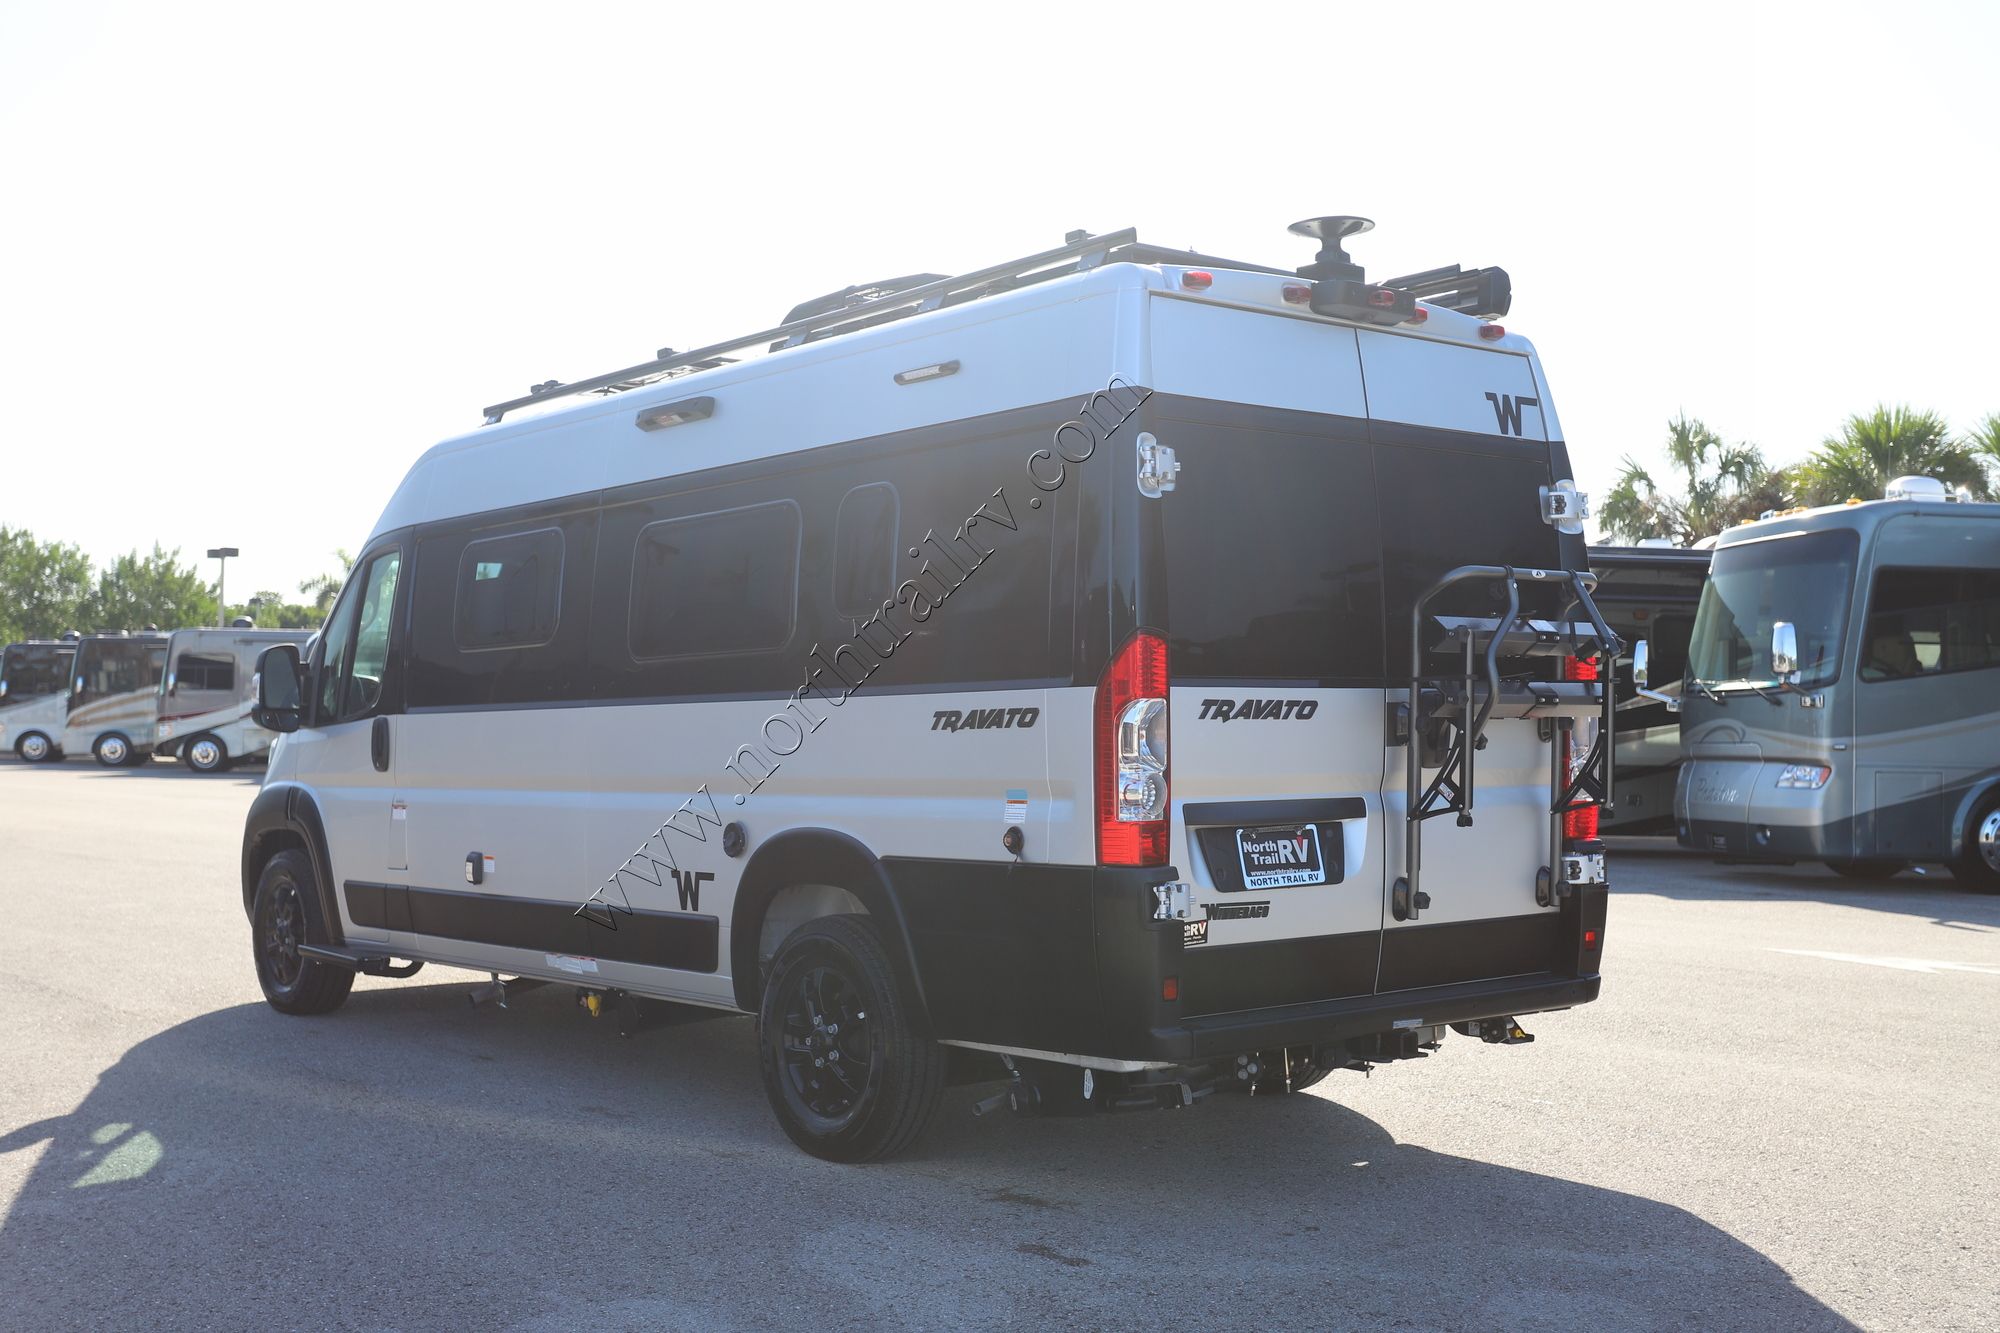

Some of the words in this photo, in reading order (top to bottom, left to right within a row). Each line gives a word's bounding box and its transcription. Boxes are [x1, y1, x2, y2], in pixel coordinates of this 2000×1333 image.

[1198, 699, 1319, 723] TRAVATO
[930, 707, 1040, 733] TRAVATO
[1242, 840, 1278, 853] North
[1277, 838, 1309, 864] RV
[1251, 852, 1280, 865] Trail
[1250, 876, 1280, 887] NORTH
[1281, 874, 1307, 884] TRAIL
[1308, 873, 1319, 881] RV
[1190, 922, 1207, 936] RV
